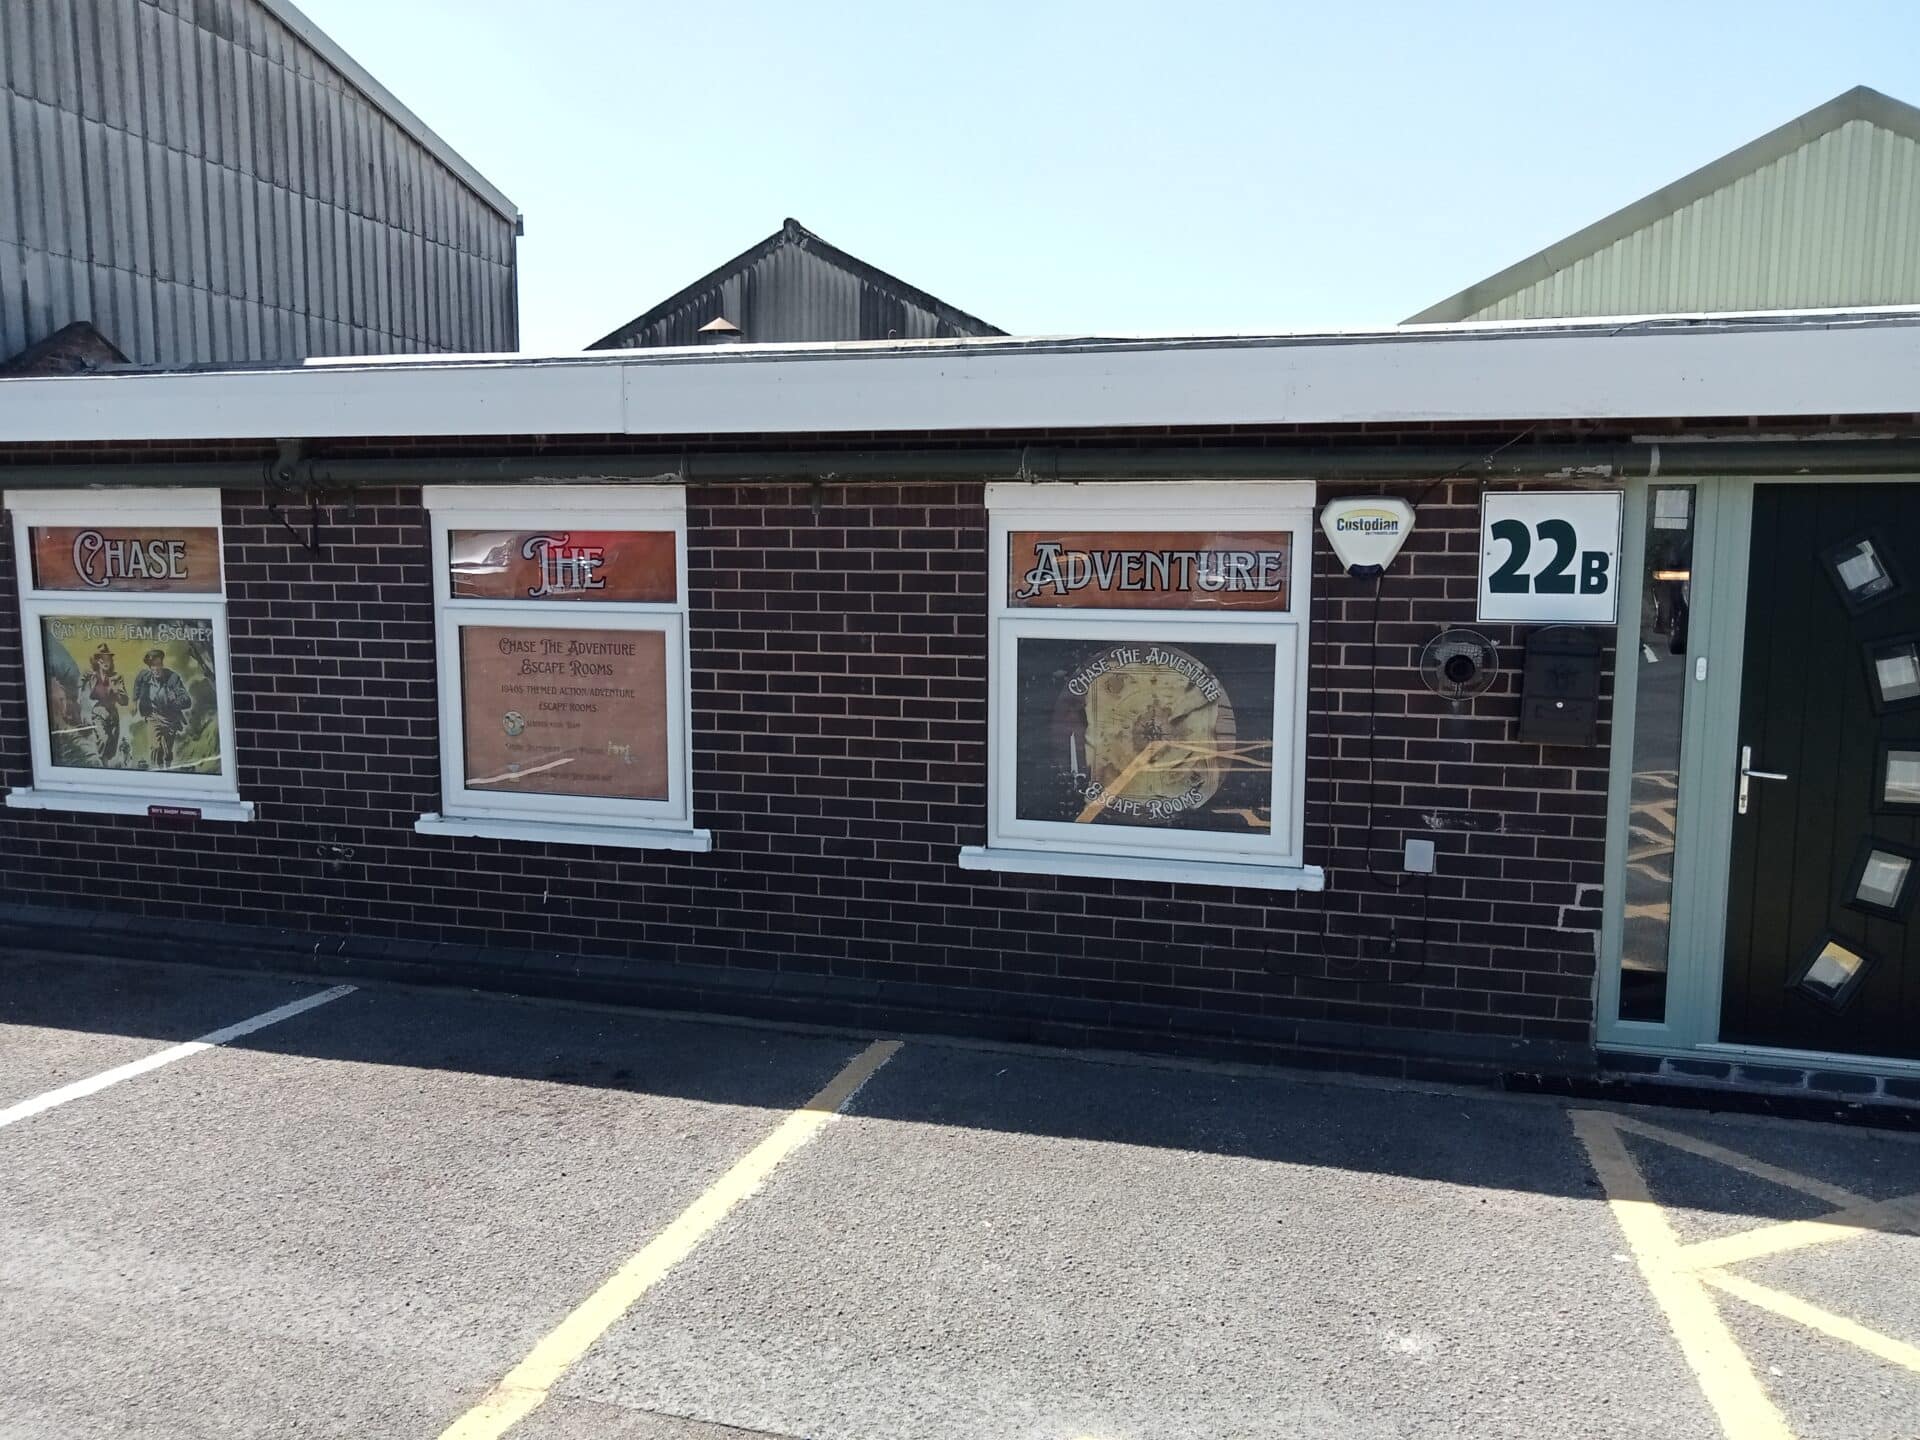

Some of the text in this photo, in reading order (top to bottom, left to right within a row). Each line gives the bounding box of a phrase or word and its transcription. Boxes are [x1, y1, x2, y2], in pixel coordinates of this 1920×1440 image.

[1336, 518, 1399, 531] Custodian
[72, 530, 188, 588] CHASE
[522, 533, 606, 597] THE
[1015, 542, 1284, 599] ADVENTURE
[1488, 518, 1610, 594] 22B
[80, 622, 116, 641] YOUR
[120, 623, 153, 642] TEAM
[499, 638, 637, 656] CHASE THE ADVENTURE
[518, 659, 613, 677] ESCAPE ROOMS
[1068, 646, 1221, 701] CHASE THE ADVENTURE
[539, 702, 598, 713] ESCAPE ROOMS
[1079, 782, 1203, 819] ESCAPE ROOMS
